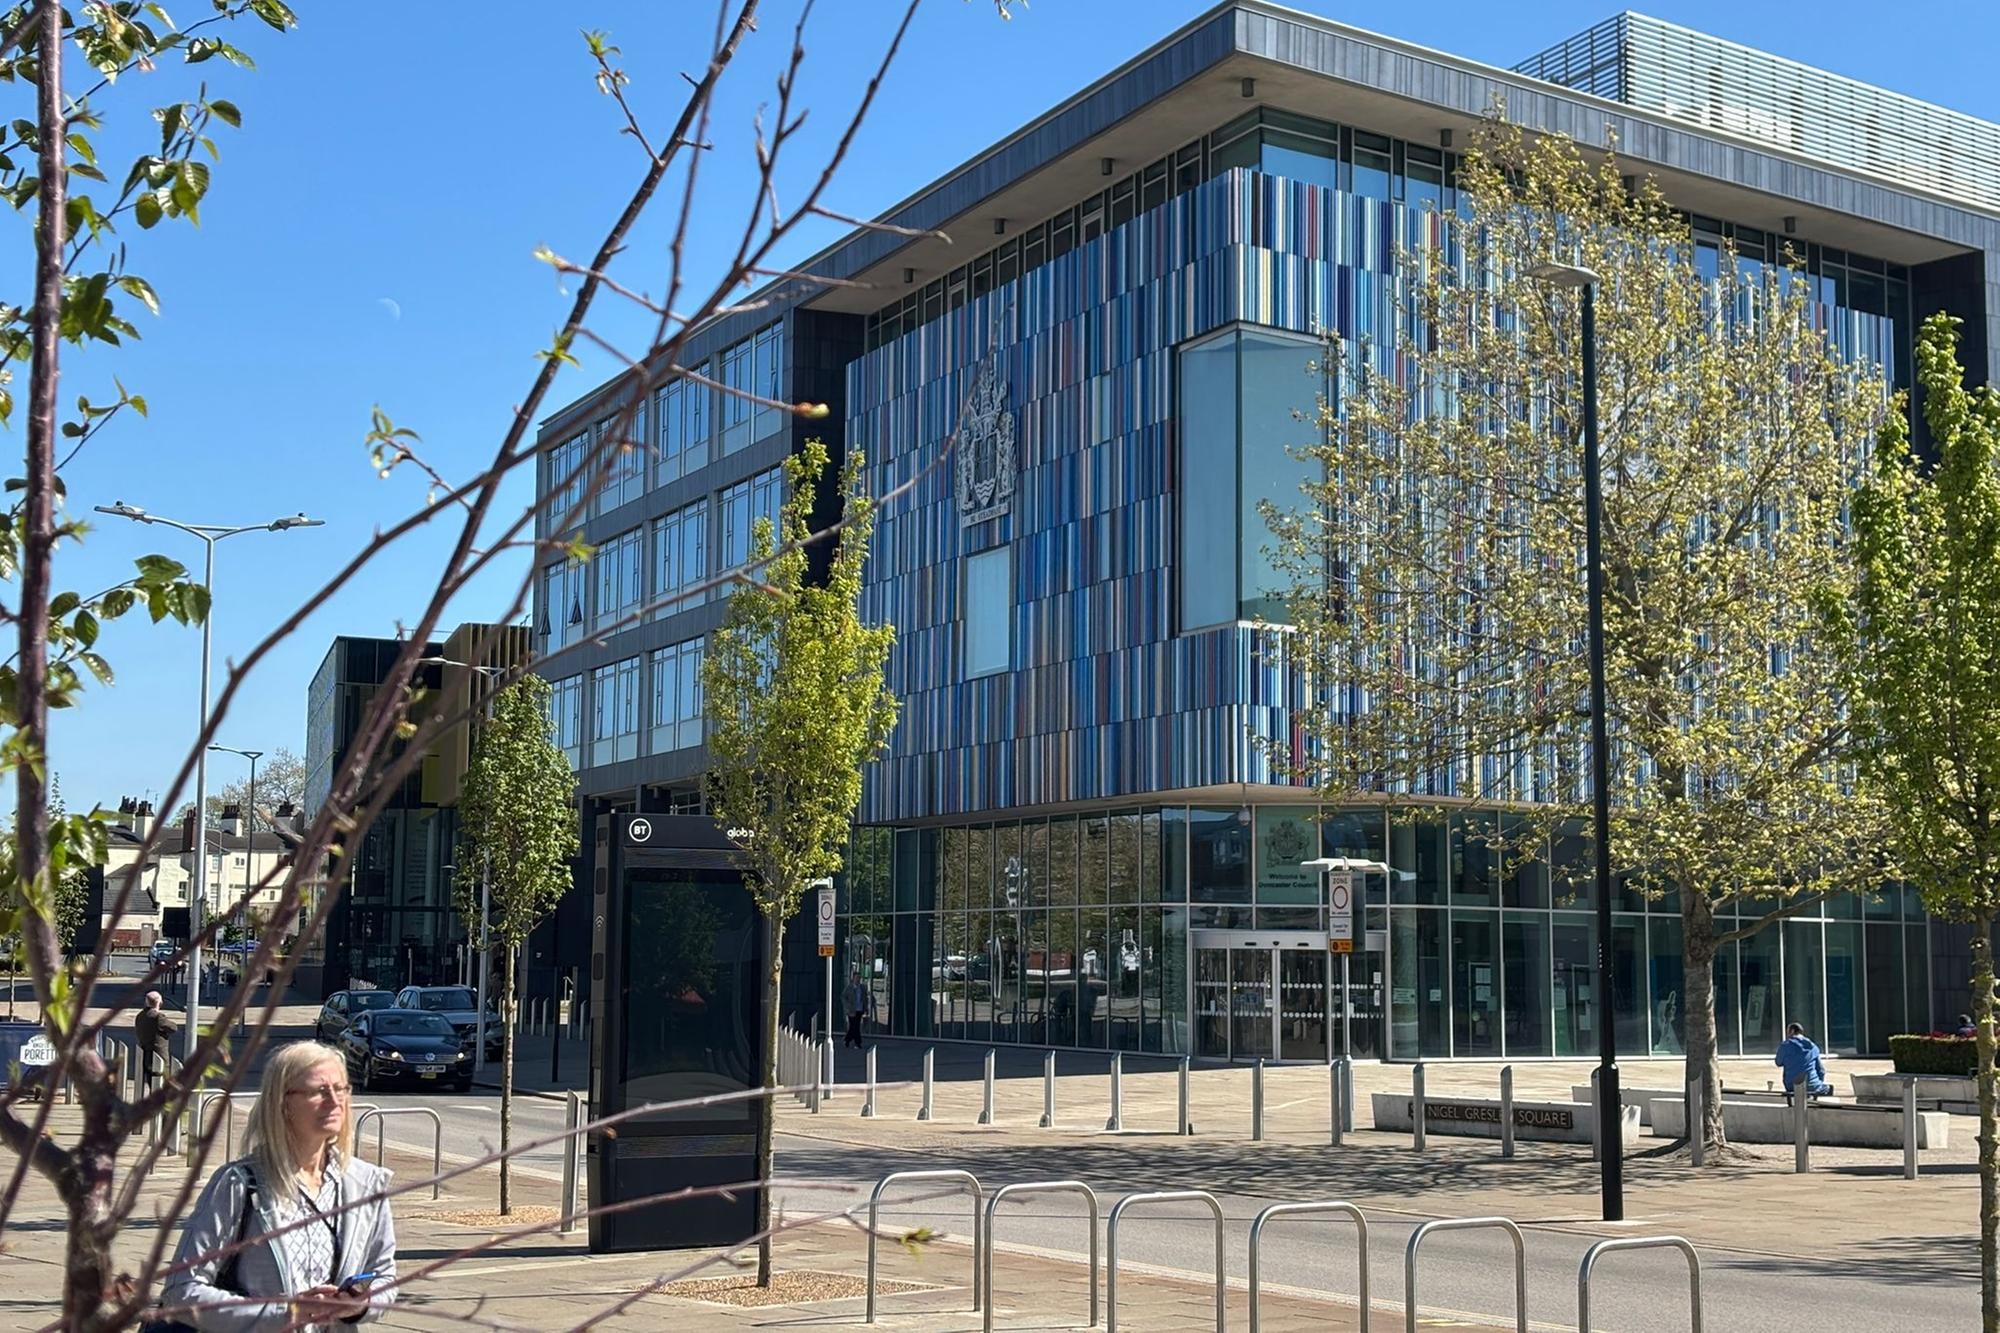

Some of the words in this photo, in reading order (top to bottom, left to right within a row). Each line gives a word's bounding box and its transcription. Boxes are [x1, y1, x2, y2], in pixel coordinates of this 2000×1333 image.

[633, 825, 647, 835] BT
[727, 827, 755, 839] globa
[1428, 1105, 1460, 1120] NIGEL
[1518, 1110, 1567, 1127] SQUARE
